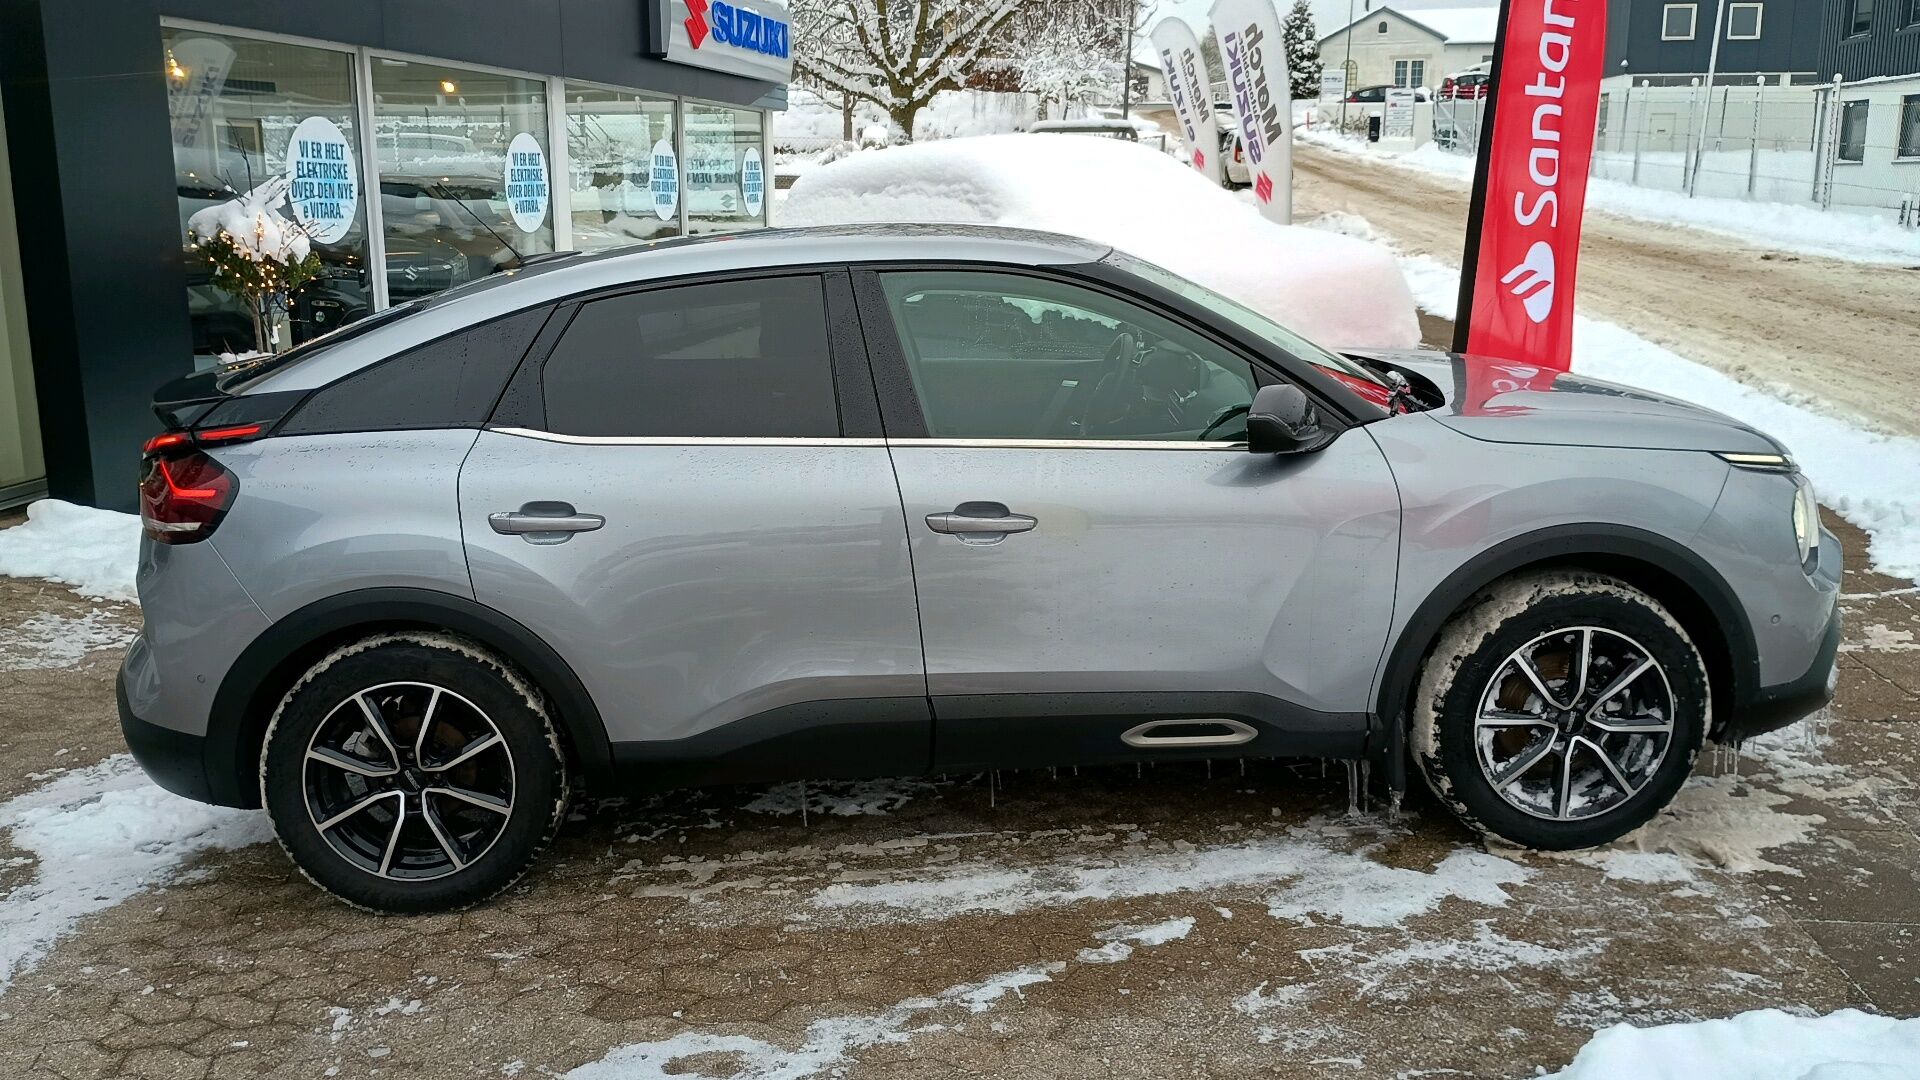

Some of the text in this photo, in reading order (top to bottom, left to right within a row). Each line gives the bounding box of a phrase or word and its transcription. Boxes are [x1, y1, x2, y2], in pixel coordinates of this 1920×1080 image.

[711, 0, 788, 59] SUZUKI
[298, 141, 344, 160] VI ER HELT
[512, 153, 540, 166] VI ER HELT
[296, 160, 348, 180] ELEKTRISKE
[511, 169, 542, 182] ELEKTRISKE
[292, 181, 354, 200] OVER DEN NYE
[508, 184, 546, 198] OVER DEN NYE
[304, 202, 344, 219] e VITARA.
[515, 203, 518, 214] e
